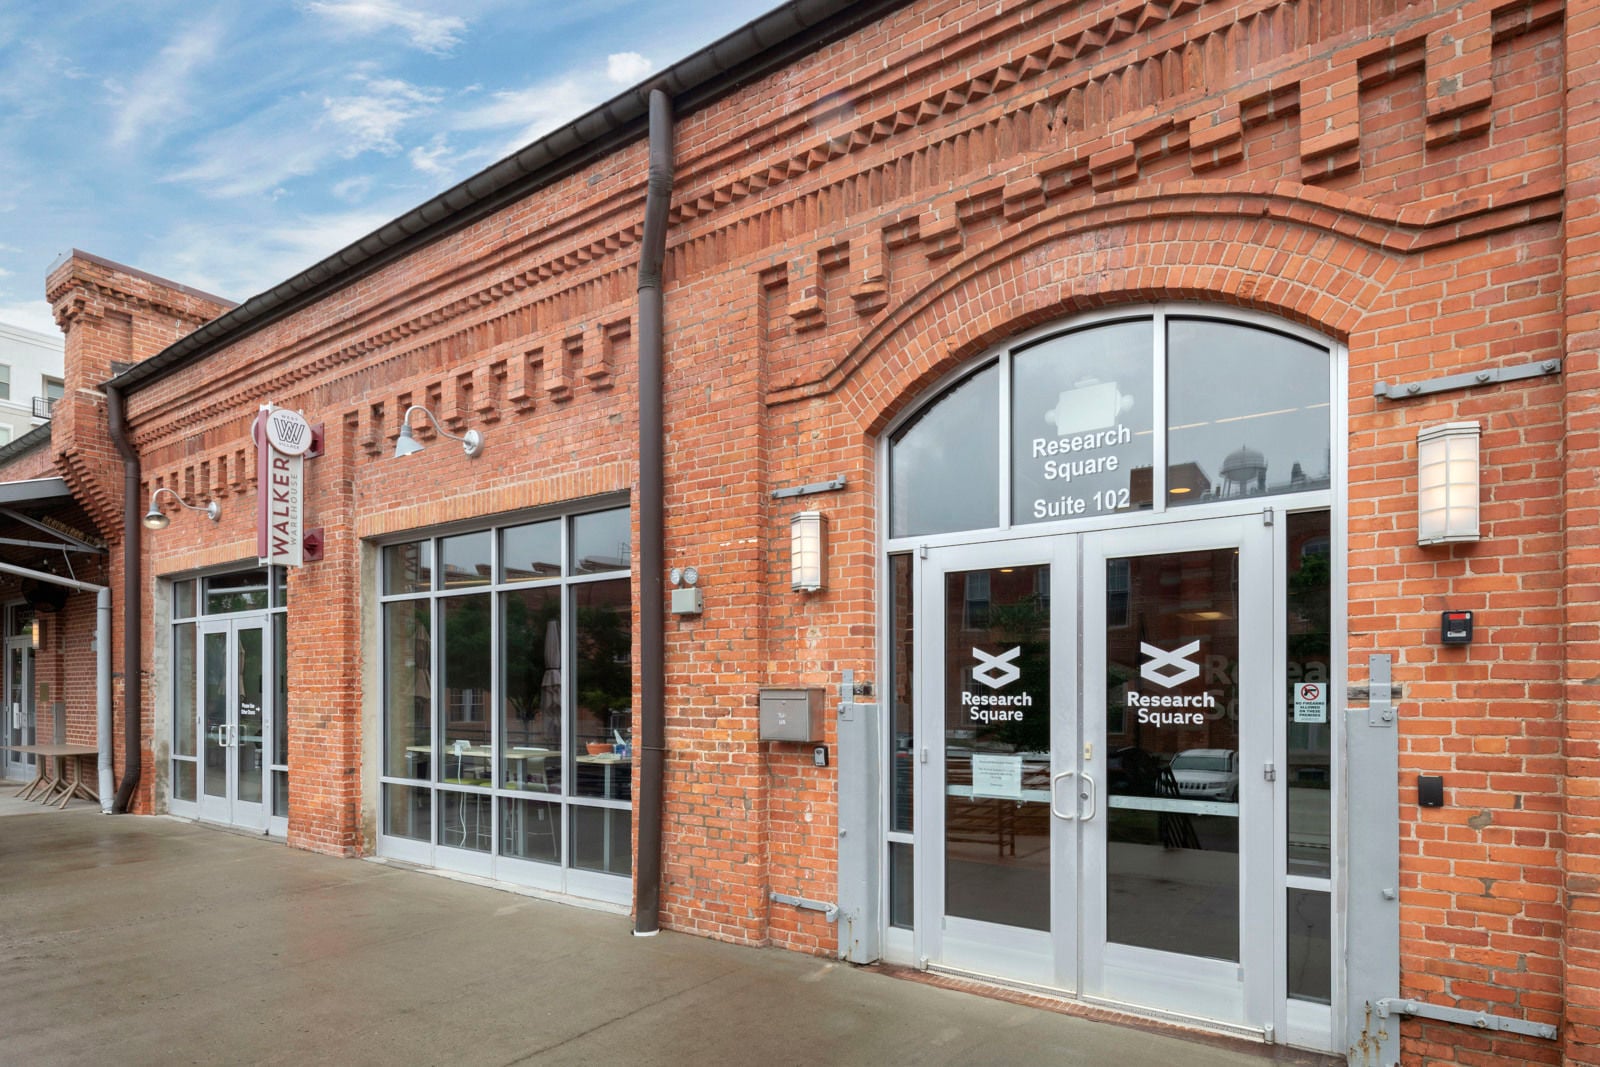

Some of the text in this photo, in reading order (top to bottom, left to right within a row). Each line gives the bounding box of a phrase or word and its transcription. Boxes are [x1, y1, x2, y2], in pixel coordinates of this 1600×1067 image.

[1032, 423, 1131, 458] Research
[1043, 455, 1119, 482] Square
[272, 457, 290, 556] WALKER
[290, 473, 298, 546] WAREHOUSE
[1033, 487, 1130, 519] Suite 102
[961, 690, 1033, 707] Research
[1127, 691, 1215, 708] Research
[970, 706, 1024, 725] Square
[1137, 708, 1205, 728] Square
